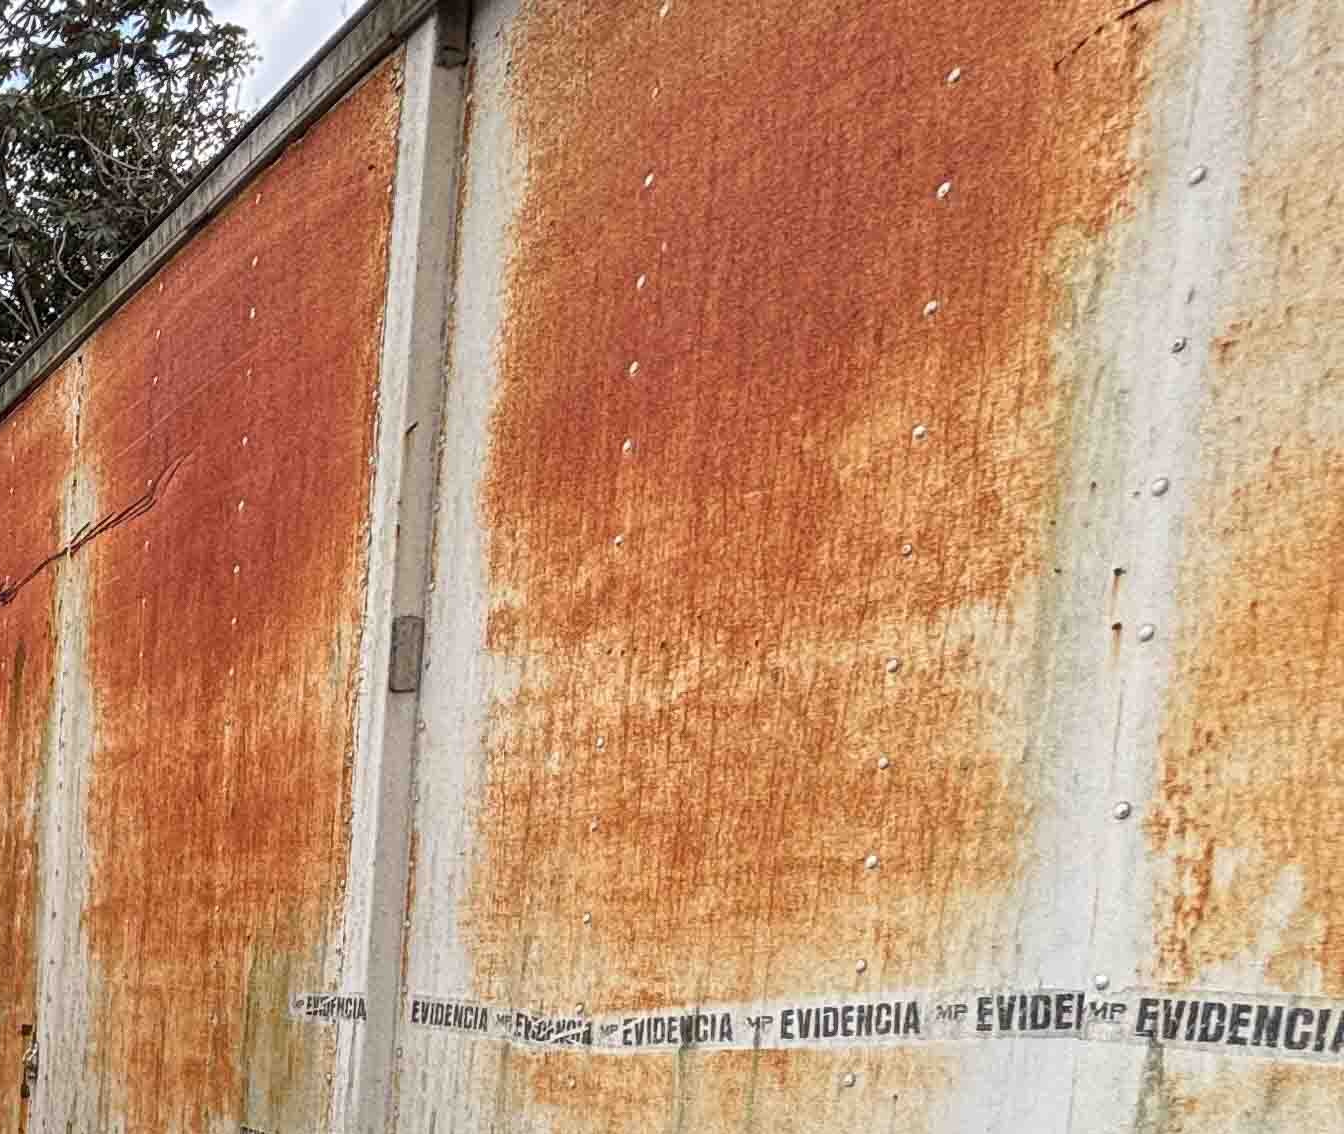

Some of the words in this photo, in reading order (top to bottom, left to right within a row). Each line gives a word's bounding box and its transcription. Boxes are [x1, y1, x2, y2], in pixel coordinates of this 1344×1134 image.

[411, 1000, 488, 1032] EVIDENCIA
[622, 1013, 733, 1047] EVIDENCIA
[781, 1001, 920, 1040] EVIDENCIA
